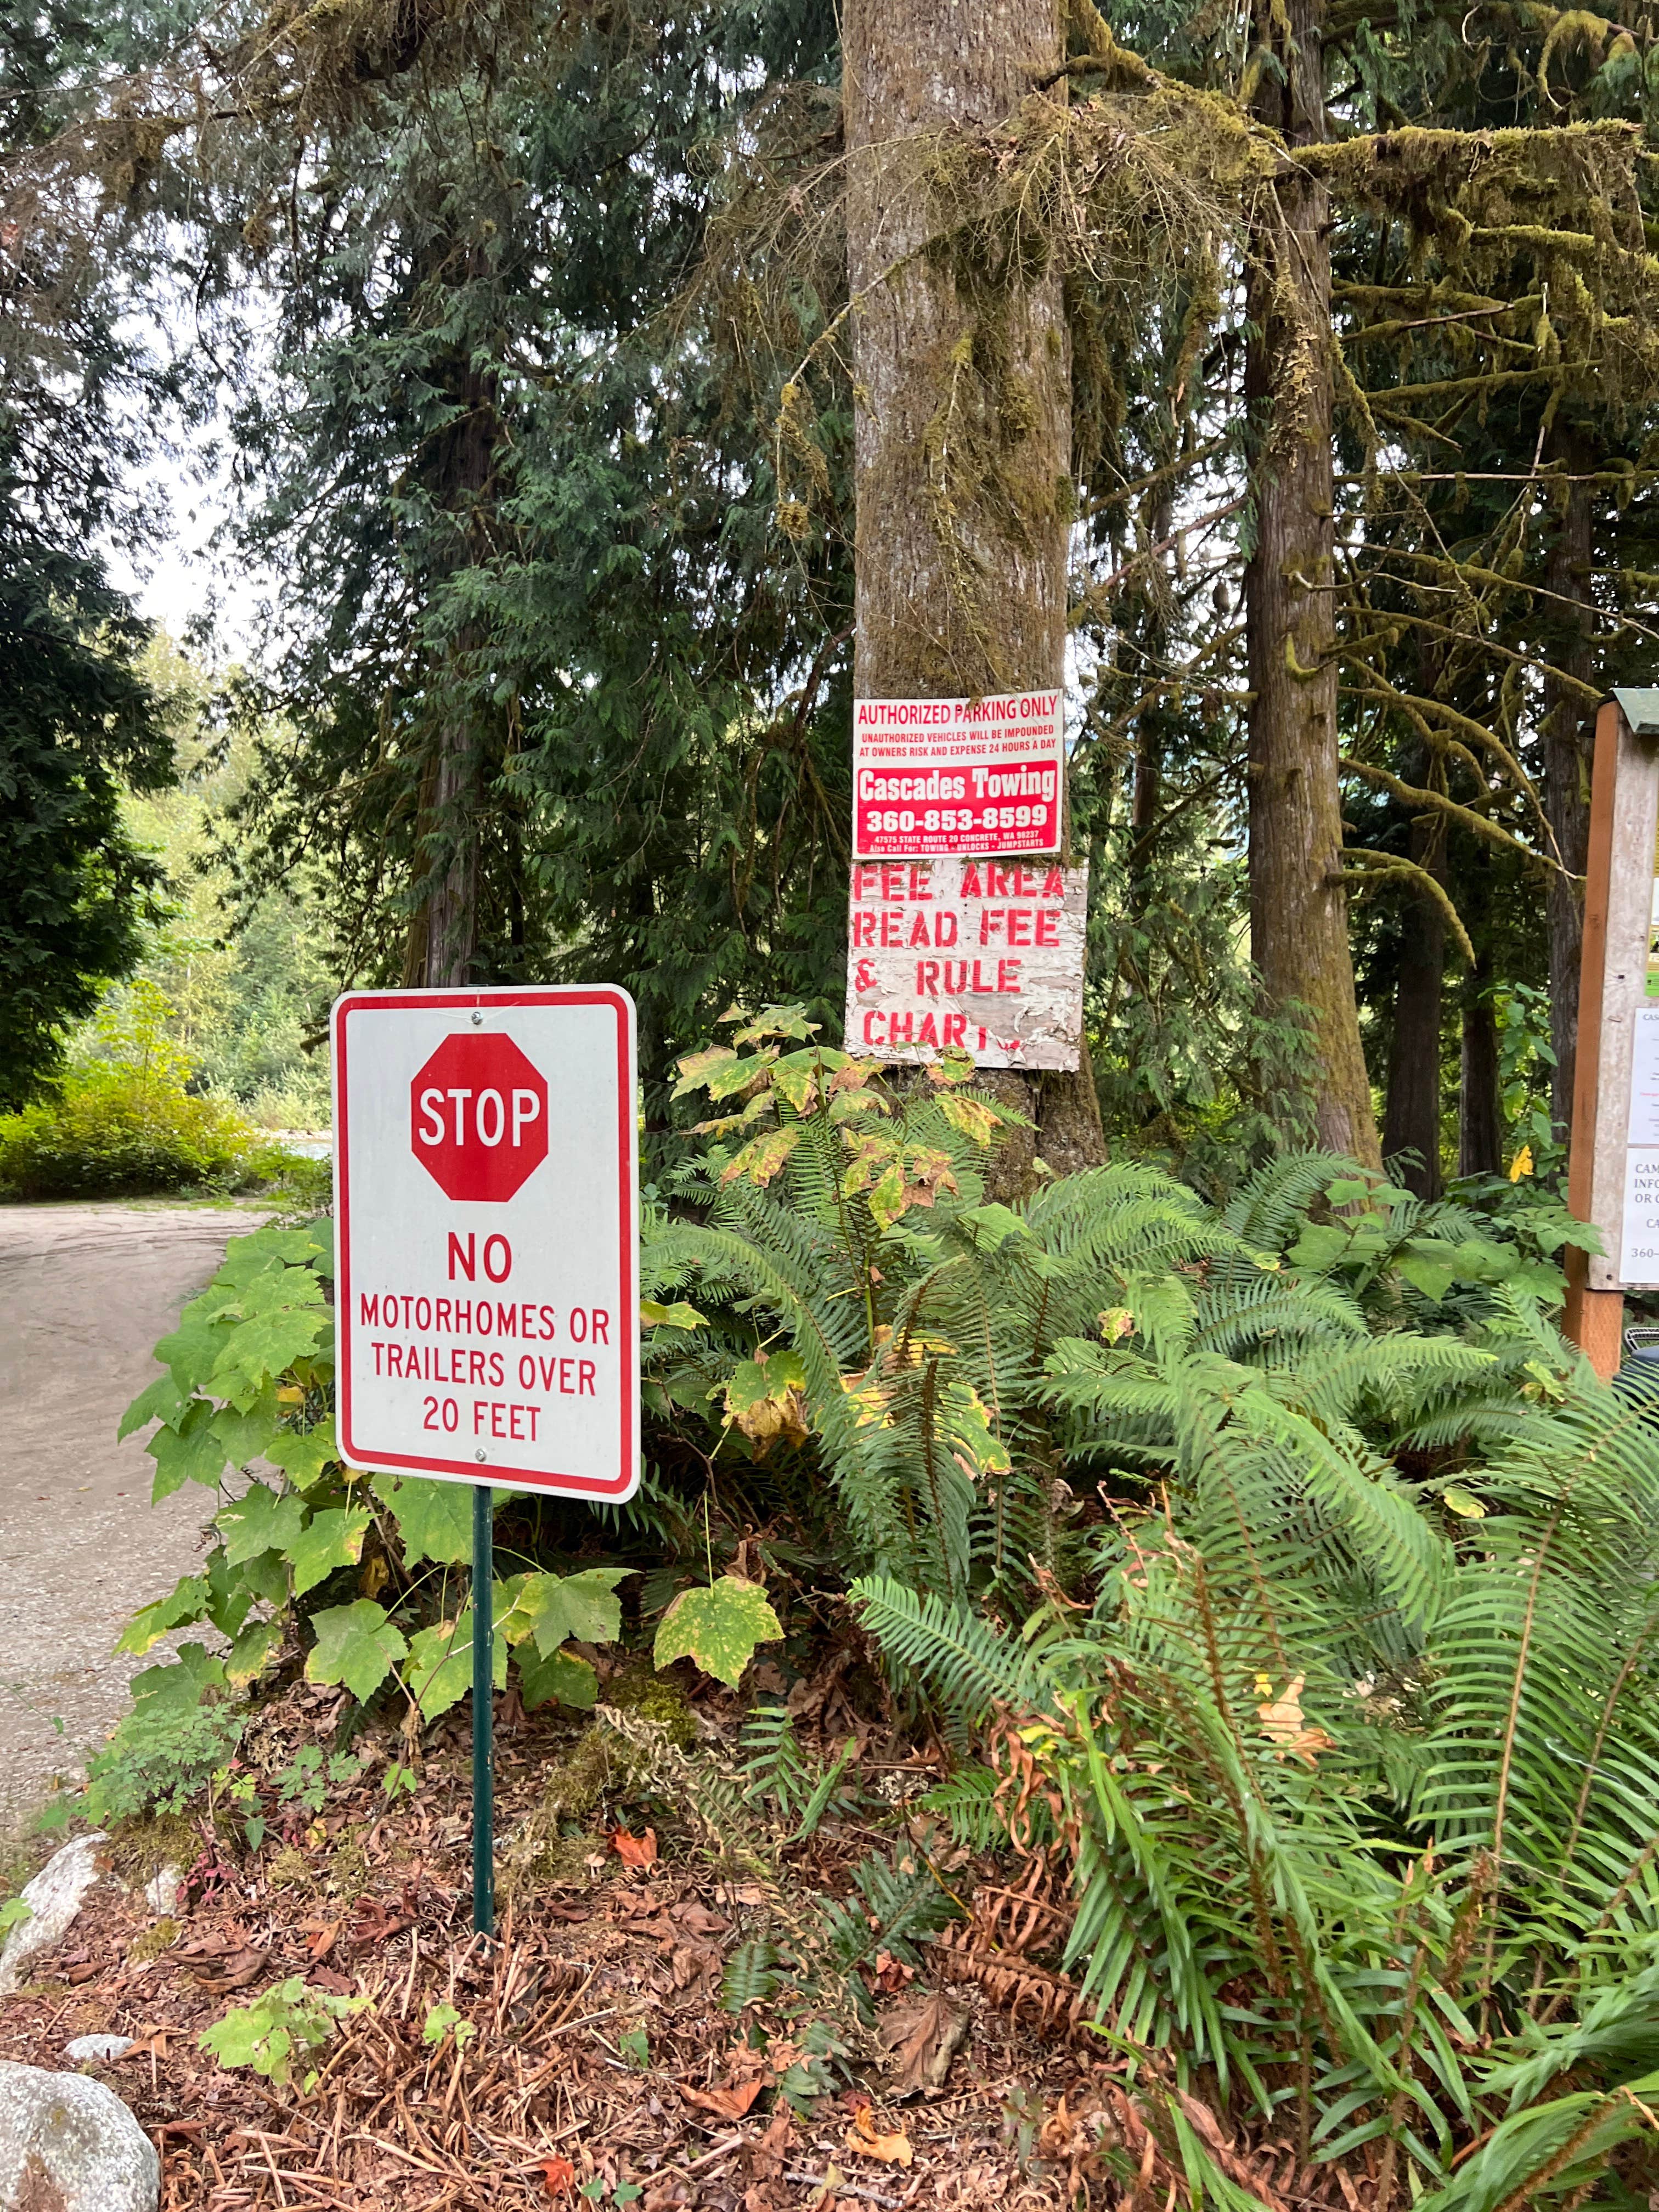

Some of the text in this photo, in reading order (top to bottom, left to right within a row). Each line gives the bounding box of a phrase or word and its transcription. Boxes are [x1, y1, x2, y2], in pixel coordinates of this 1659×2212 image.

[858, 695, 1058, 725] AUTHORIZED PARKING ONLY
[860, 738, 1057, 757] AT OWNERS RISK AND EXPENSE 24 HOURS A DAY
[862, 725, 1054, 743] UNAUTHORIZED VEHICLES WILL BE IMPOUNDED
[859, 764, 1056, 802] Cascades Towing
[866, 804, 1047, 832] 360-853-8599
[868, 844, 885, 853] Also
[887, 844, 902, 853] Call
[904, 844, 918, 853] For:
[920, 843, 949, 852] TOWING
[957, 842, 990, 851] UNLOCKS
[997, 838, 1044, 850] JUMPSTARTS
[874, 835, 898, 844] 47575
[899, 835, 921, 843] STATE
[923, 834, 947, 843] ROUTE
[949, 834, 958, 843] 20
[960, 833, 1001, 842] CONCRETE,
[1003, 832, 1015, 840] WA
[854, 862, 1065, 901] FEE AREA
[853, 909, 1061, 948] READ FEE
[855, 958, 1022, 996] & RULE
[419, 1087, 540, 1147] STOP
[1635, 1193, 1652, 1203] OR
[447, 1231, 512, 1283] NO
[360, 1293, 610, 1345] MOTORHOMES OR
[371, 1342, 596, 1396] TRAILERS OVER
[423, 1395, 541, 1442] 20 FEET
